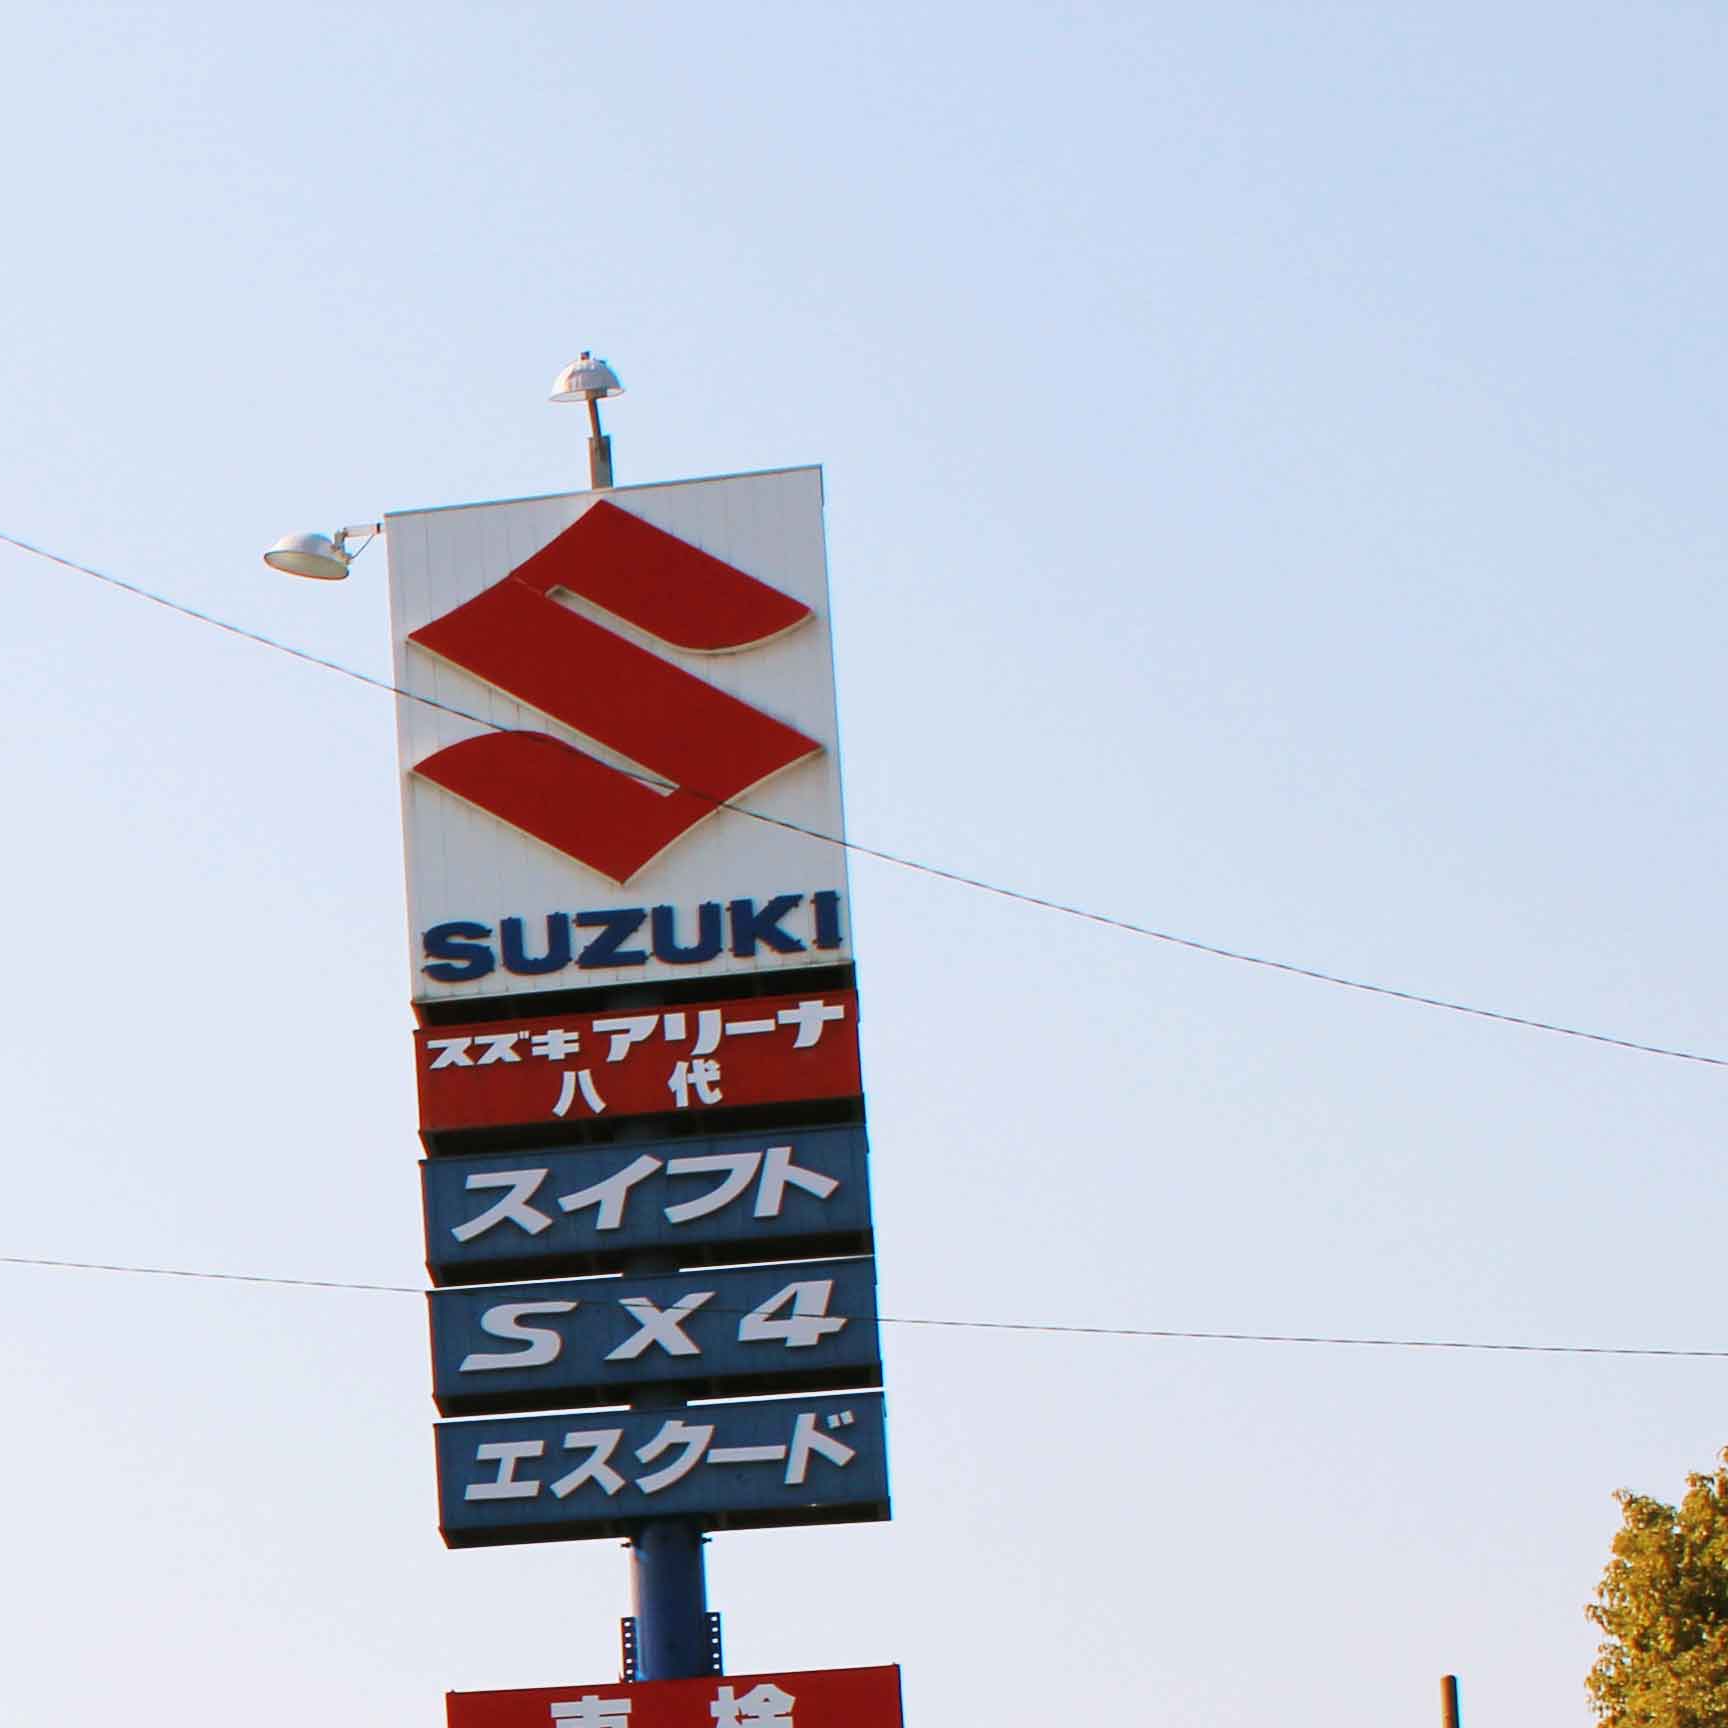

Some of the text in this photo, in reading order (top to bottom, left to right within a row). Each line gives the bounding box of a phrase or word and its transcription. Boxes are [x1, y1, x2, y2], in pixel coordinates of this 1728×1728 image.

[421, 889, 843, 984] SUZUKI
[450, 1147, 840, 1243] スイフト
[464, 1410, 855, 1501] エスクード
